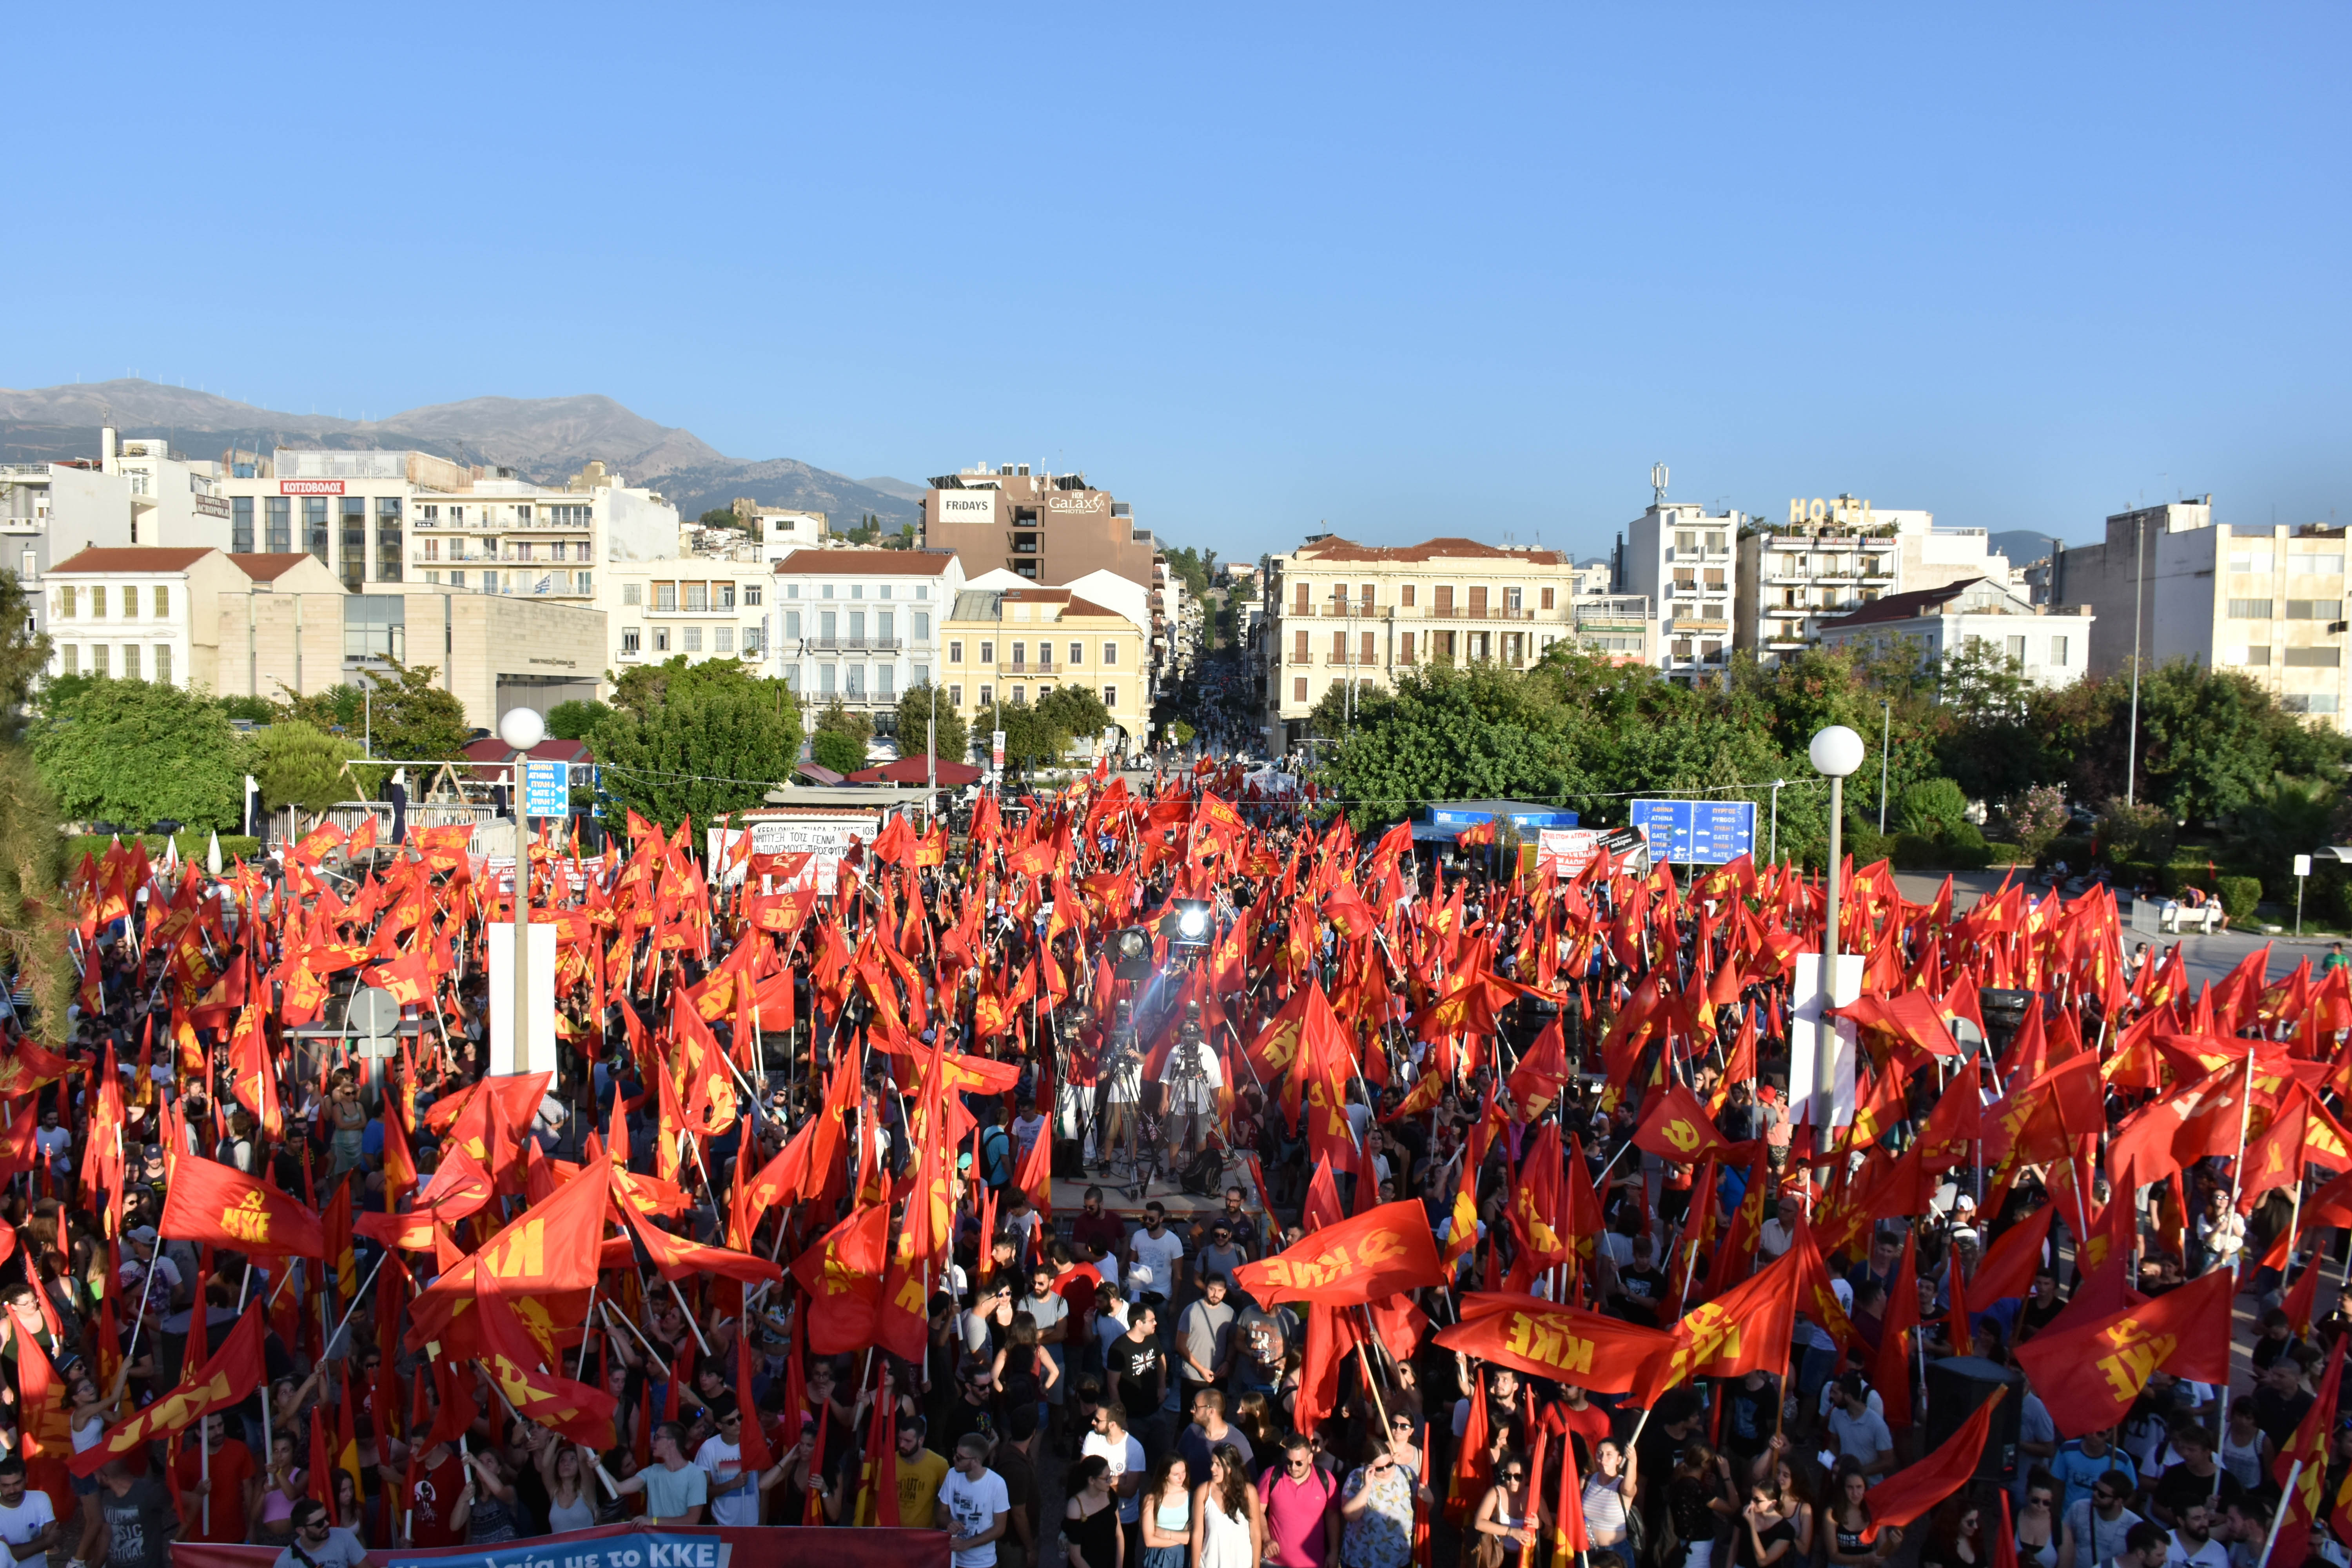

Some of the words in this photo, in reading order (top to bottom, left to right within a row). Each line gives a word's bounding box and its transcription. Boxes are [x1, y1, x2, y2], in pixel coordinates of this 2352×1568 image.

[283, 482, 341, 493] ΚΩΤΣΟΒΟΛΟΣ
[205, 497, 221, 506] HOTEL
[197, 503, 229, 517] ACROPOLE
[1790, 498, 1876, 523] HOTEL
[753, 833, 784, 843] ΝΑΠΤΥΞΗ
[790, 832, 808, 843] ΤΟΥΣ
[812, 834, 835, 844] ΓΕΝΝΑ
[565, 1553, 600, 1568] με
[608, 1550, 641, 1568] το
[649, 1543, 715, 1567] ΚΚΕ
